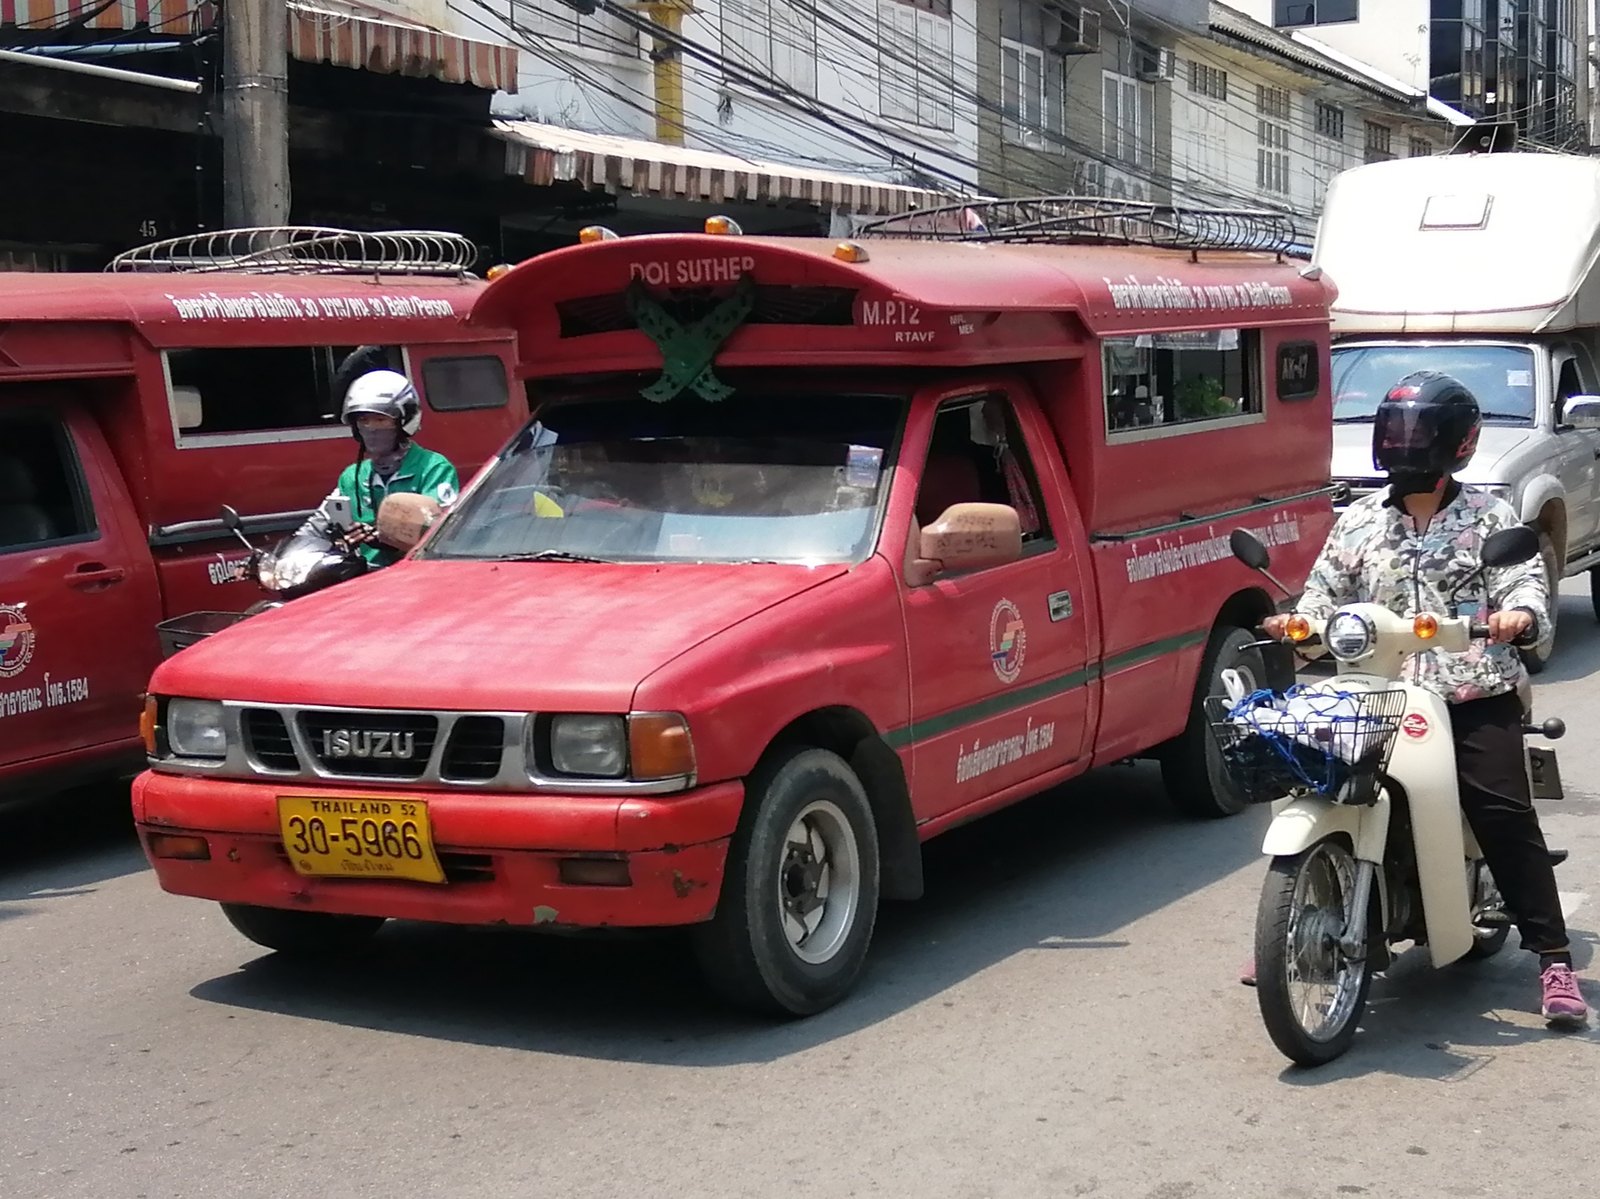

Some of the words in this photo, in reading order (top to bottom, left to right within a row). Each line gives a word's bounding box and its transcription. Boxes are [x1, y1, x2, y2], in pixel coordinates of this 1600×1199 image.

[138, 219, 157, 237] 45
[300, 297, 319, 317] 30
[322, 728, 415, 759] ISUZU
[311, 800, 392, 815] THAILAND
[400, 803, 417, 817] 52
[288, 815, 424, 860] 30-5966
